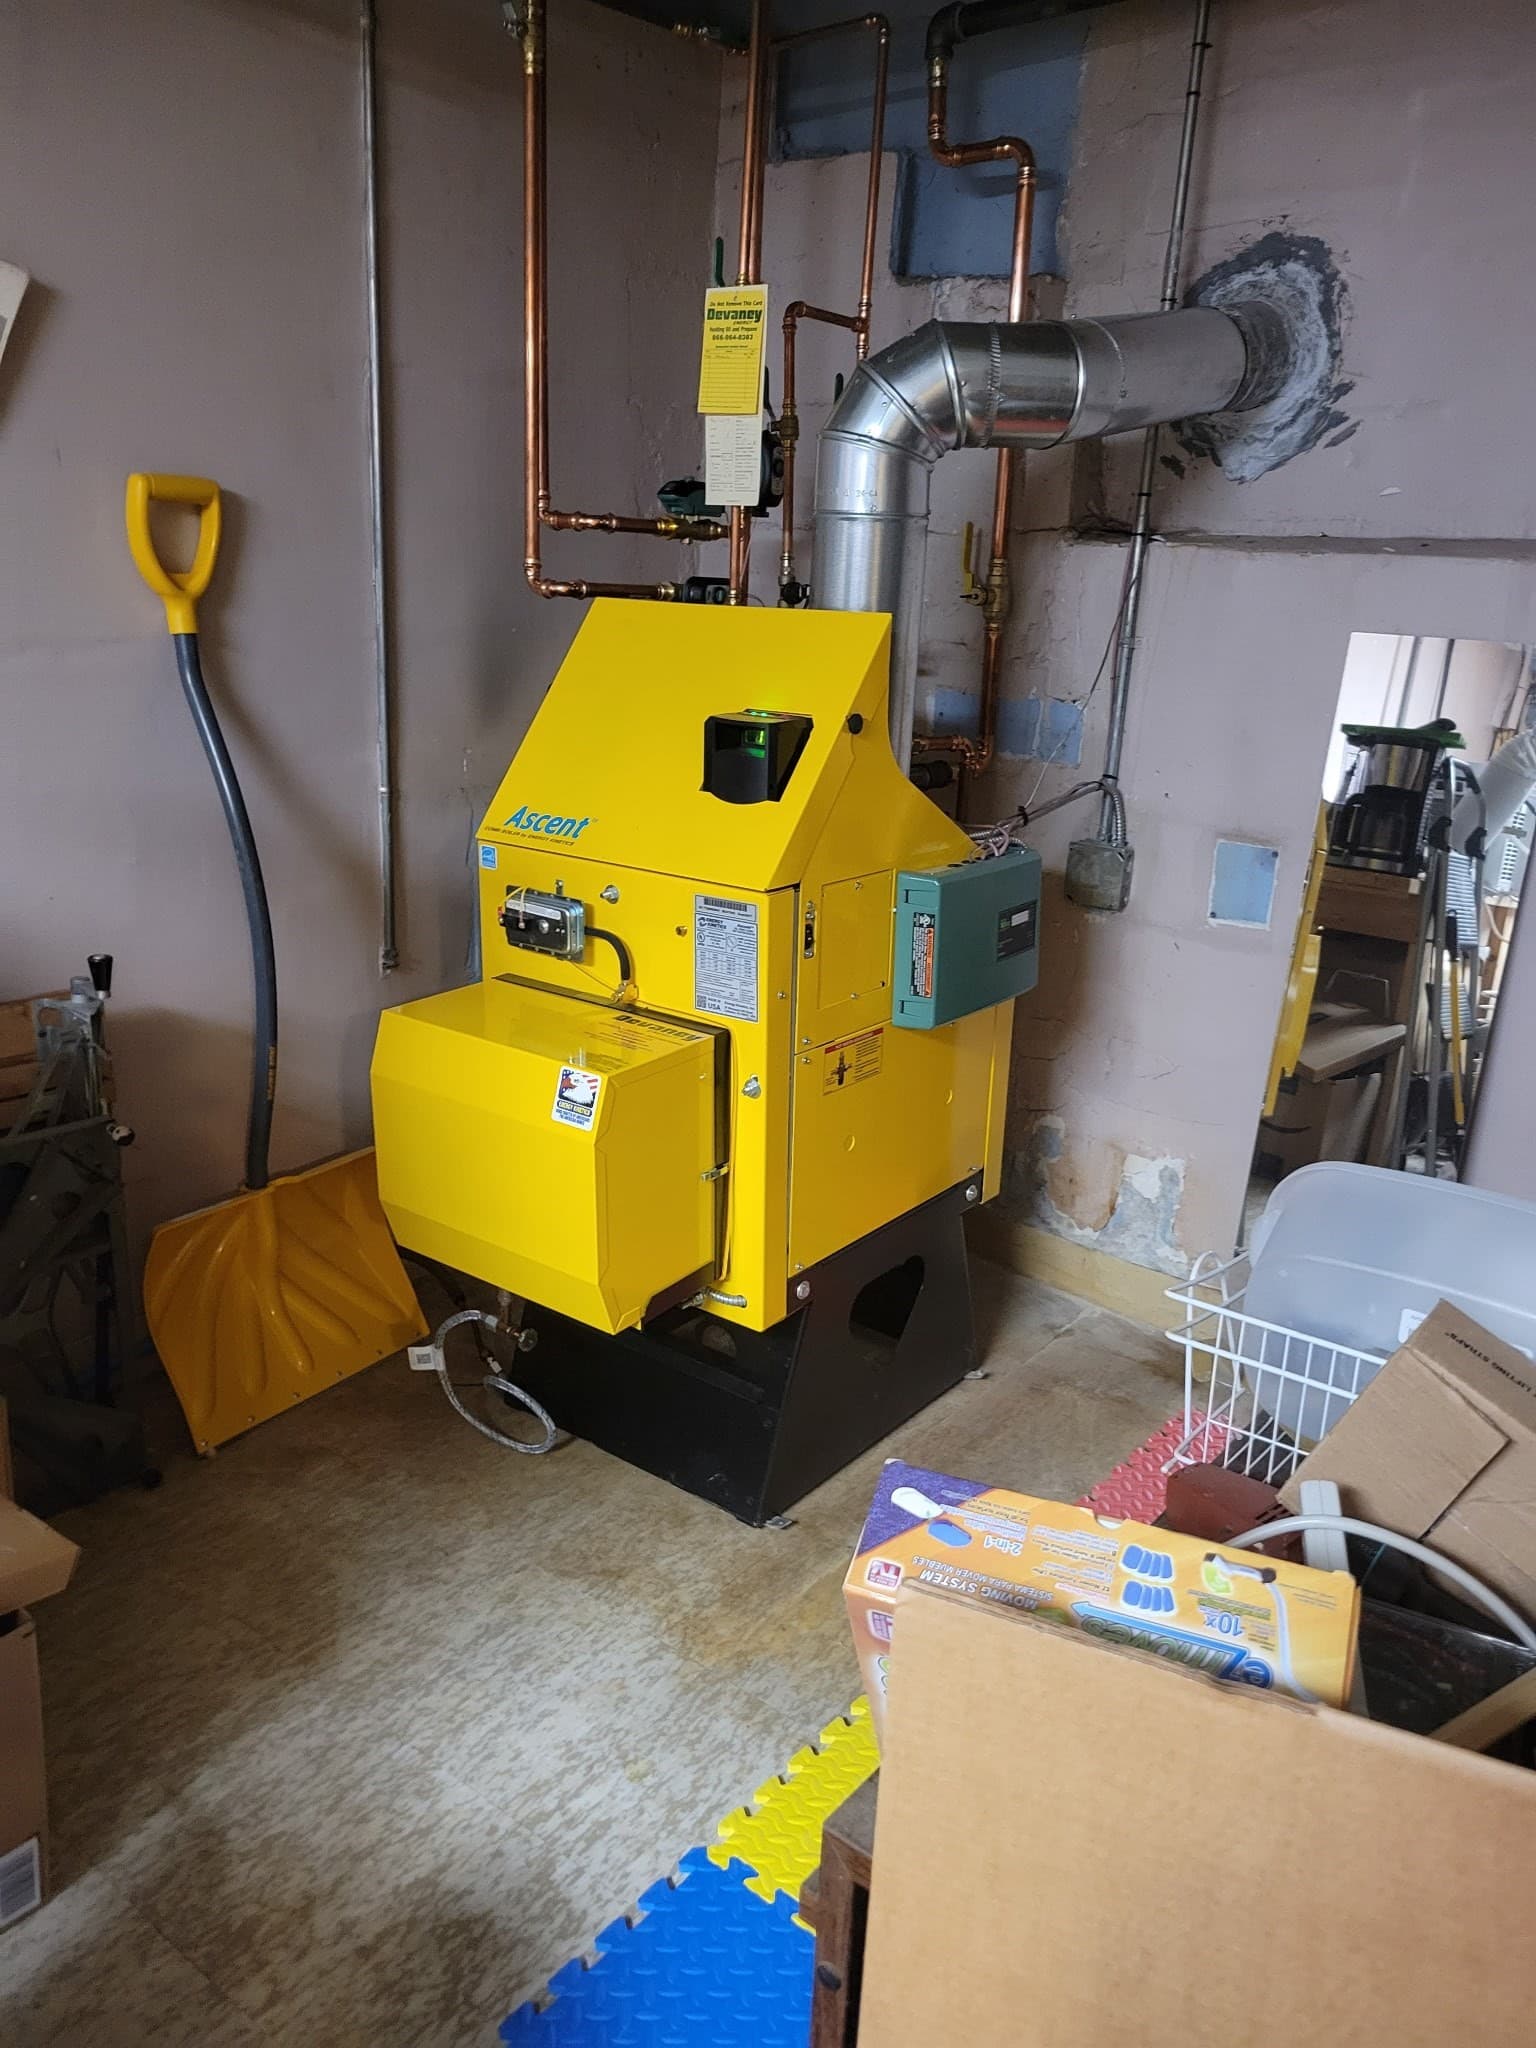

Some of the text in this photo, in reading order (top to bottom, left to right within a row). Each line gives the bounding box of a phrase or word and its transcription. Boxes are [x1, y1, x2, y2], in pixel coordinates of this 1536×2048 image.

[707, 308, 762, 323] Devaney
[504, 805, 590, 839] Ascent
[708, 1002, 720, 1010] USA
[615, 1014, 703, 1042] Devaney
[1491, 1362, 1532, 1392] LIFTING
[984, 1535, 1022, 1555] 2-in-1
[912, 1556, 955, 1575] MUEBLES
[956, 1568, 987, 1583] MOVER
[920, 1569, 978, 1593] SYSTEM
[988, 1576, 1012, 1590] PARA
[981, 1587, 1039, 1609] MOVING
[1014, 1584, 1053, 1601] SISTEMA
[1205, 1611, 1246, 1636] 10x
